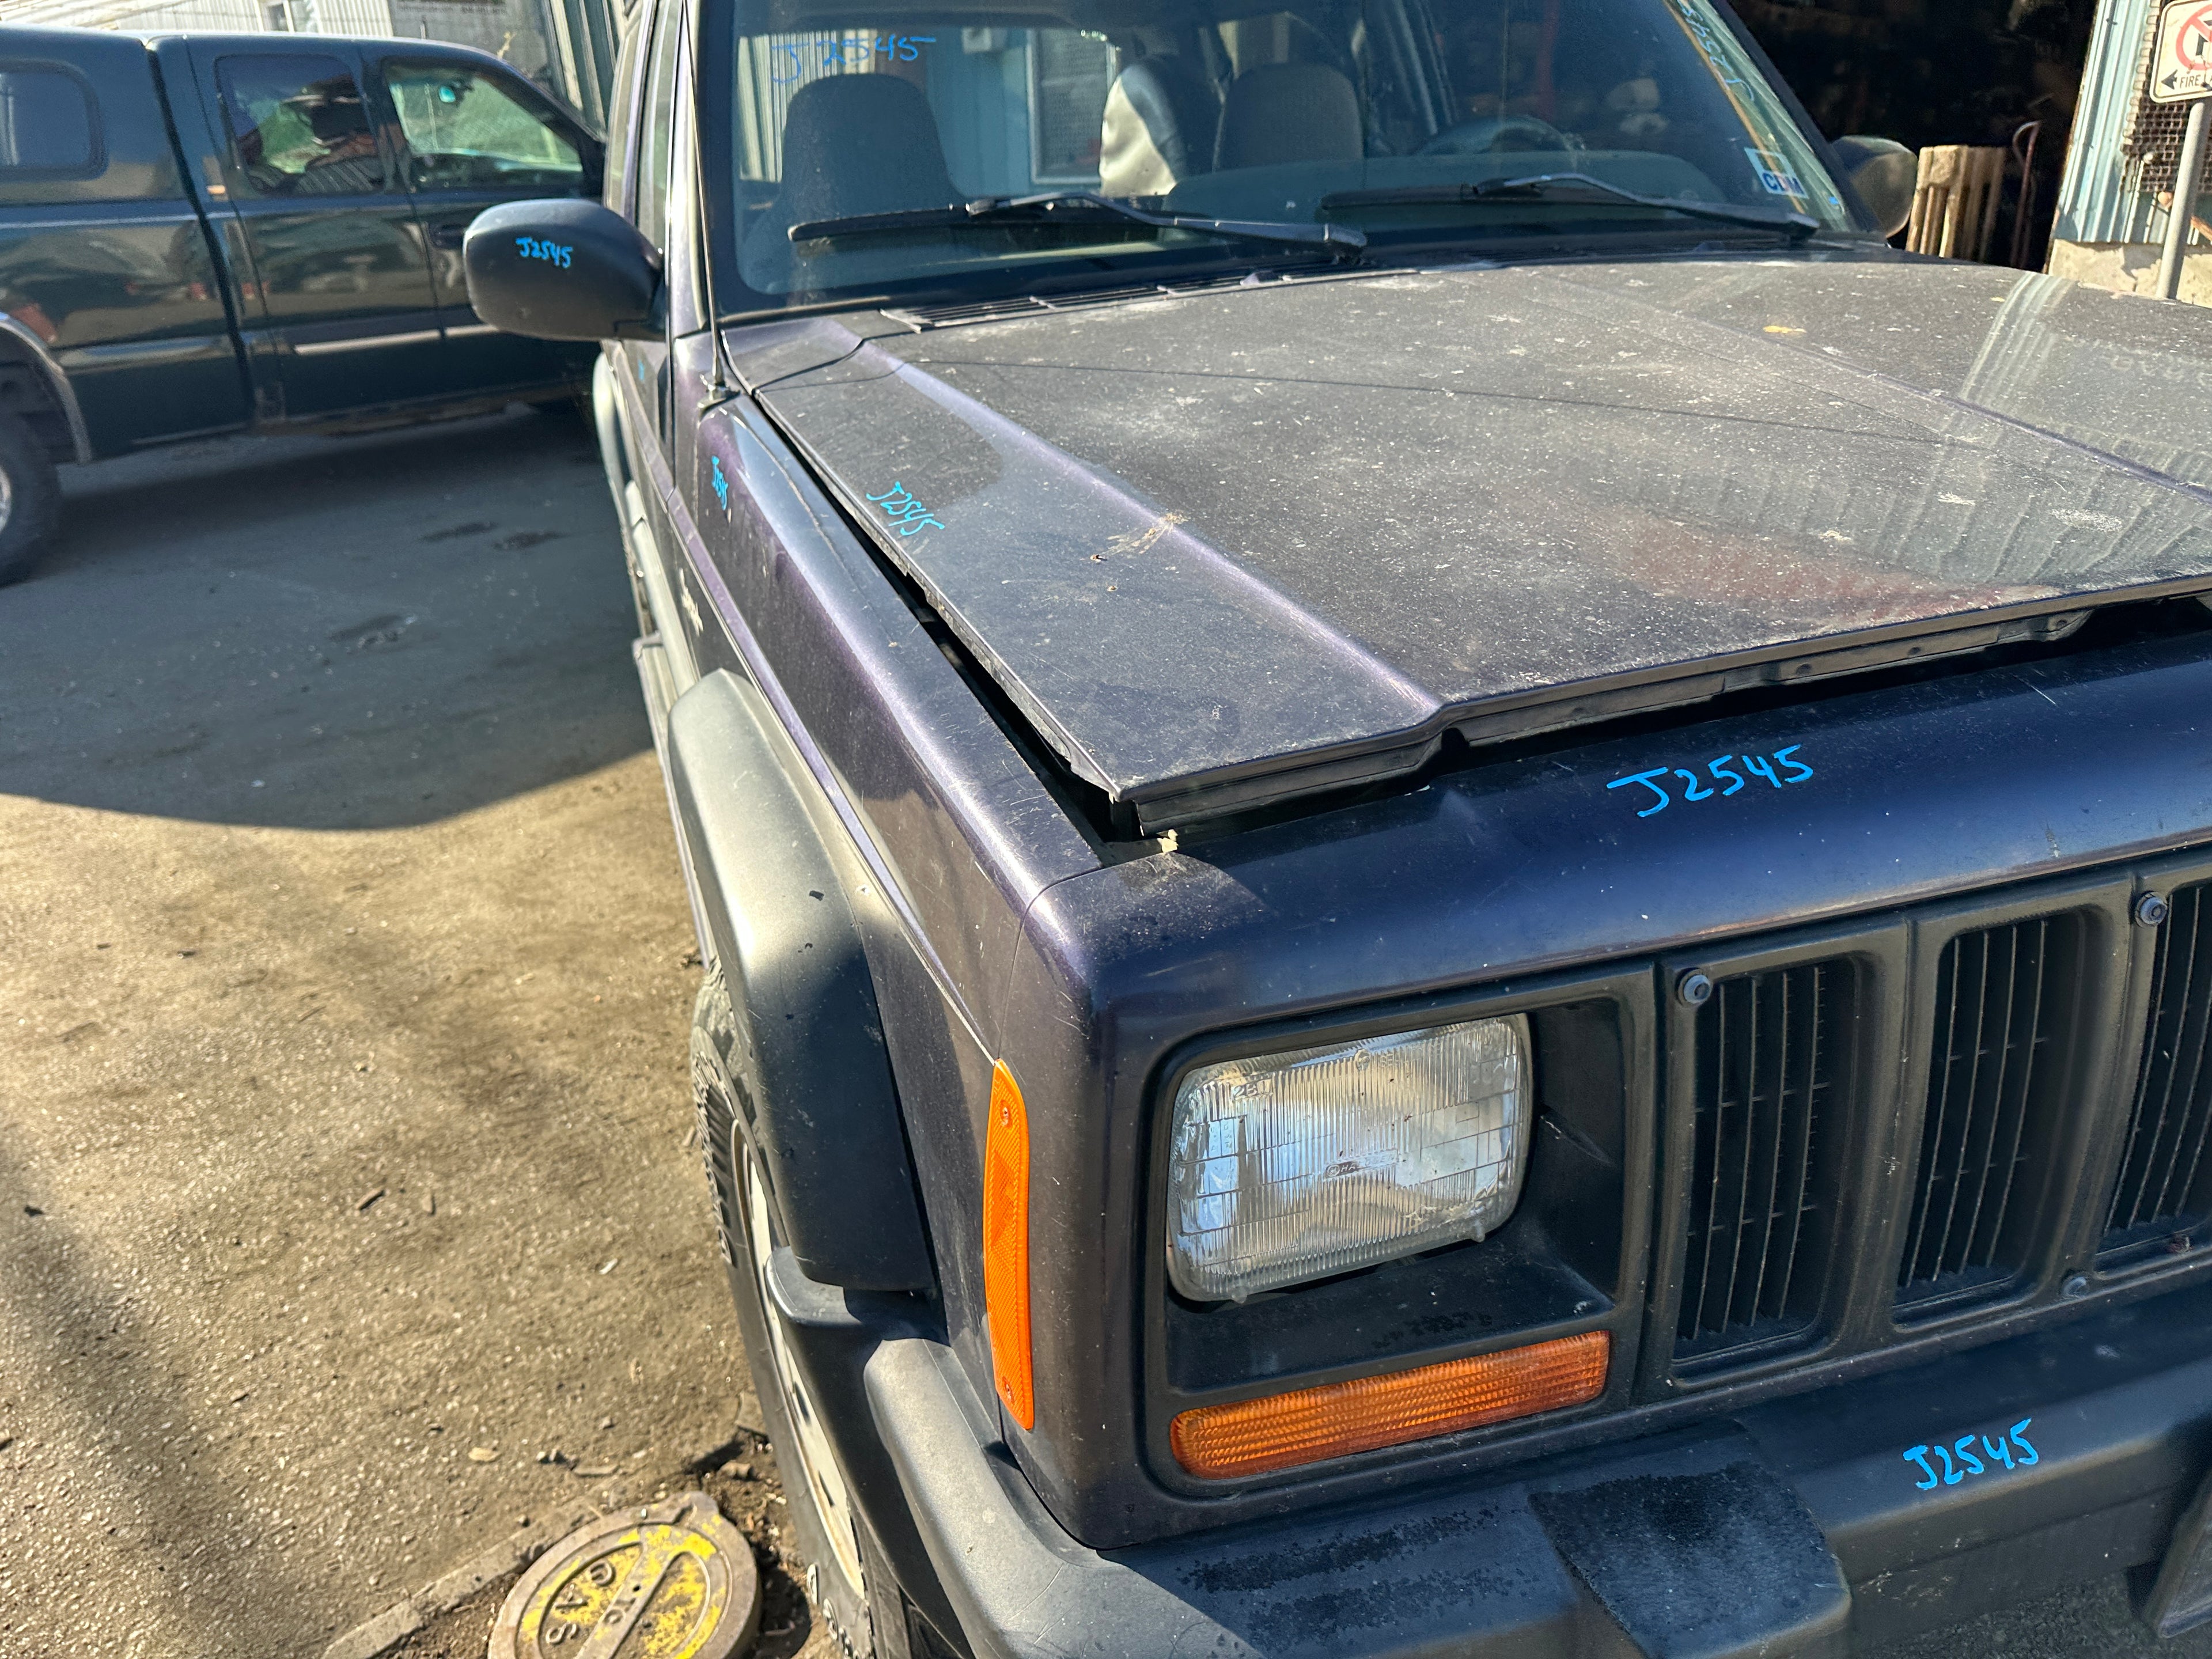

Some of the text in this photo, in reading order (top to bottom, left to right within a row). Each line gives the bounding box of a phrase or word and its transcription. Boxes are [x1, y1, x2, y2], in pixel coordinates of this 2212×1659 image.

[771, 33, 937, 84] J2545
[2180, 74, 2201, 89] FIRE
[516, 237, 573, 268] J2545
[865, 480, 945, 536] J2545
[1606, 743, 1814, 817] J2545
[1902, 1417, 2039, 1490] J2545
